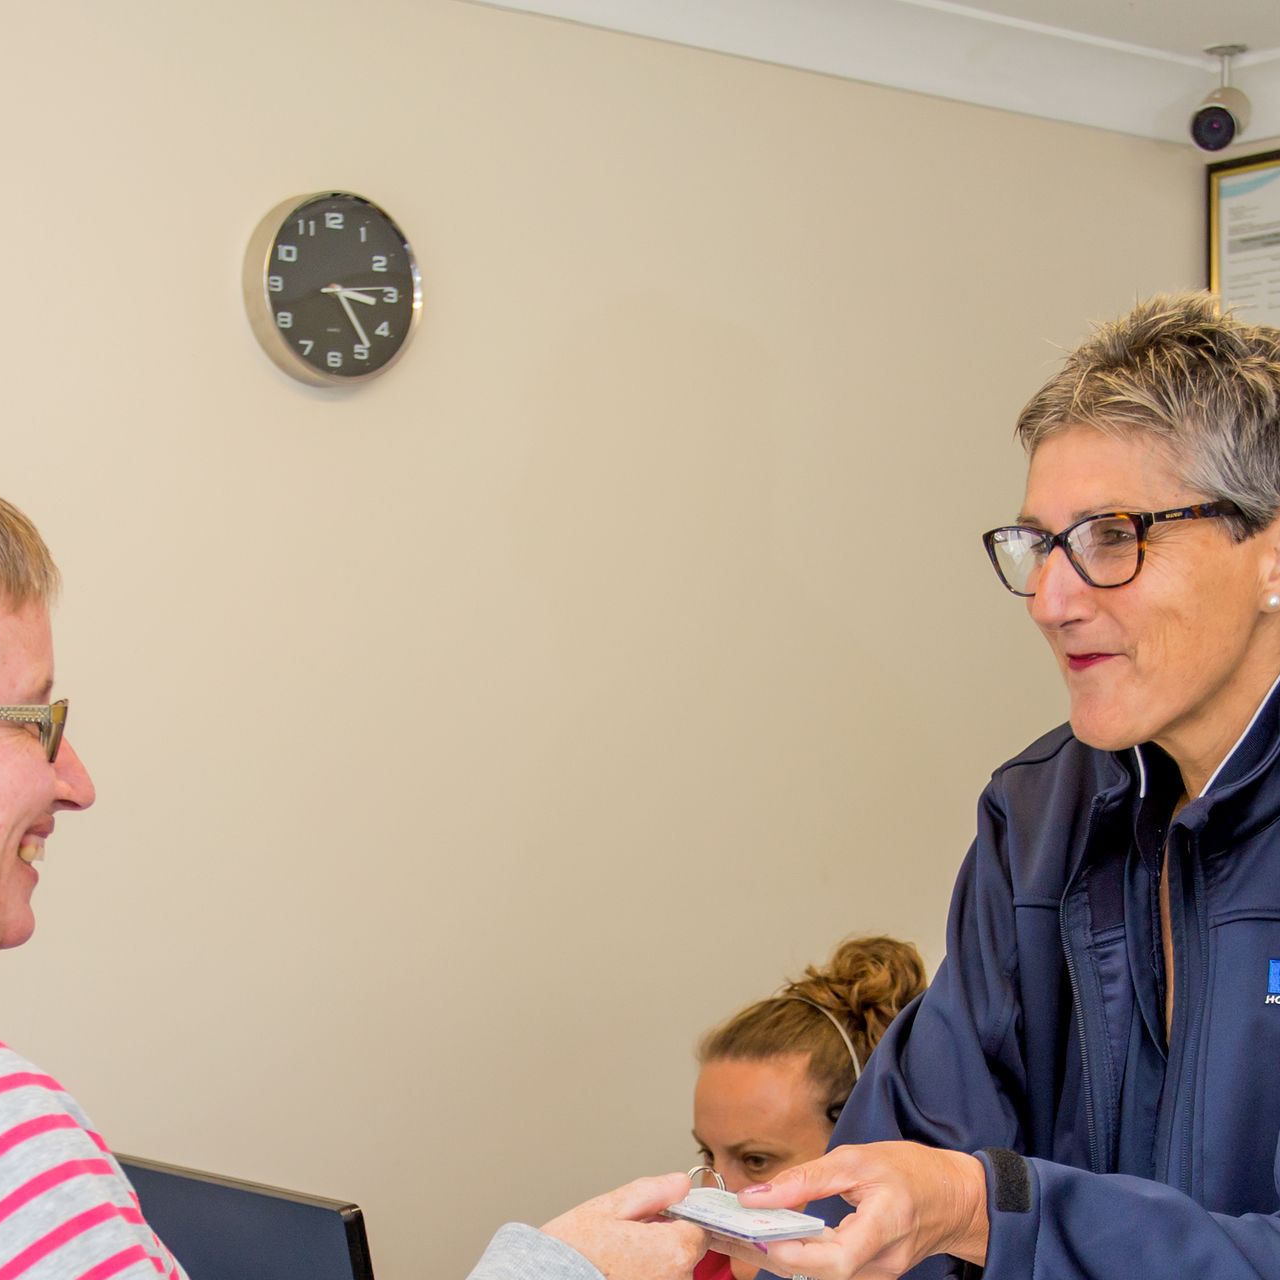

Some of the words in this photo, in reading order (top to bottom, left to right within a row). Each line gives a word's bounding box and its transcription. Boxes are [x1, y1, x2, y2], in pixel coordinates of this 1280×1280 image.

[297, 219, 316, 237] 11
[324, 212, 344, 230] 12
[359, 226, 367, 242] 1
[277, 244, 297, 262] 10
[371, 255, 388, 272] 2
[269, 275, 284, 292] 9
[382, 286, 398, 303] 3
[276, 311, 293, 328] 8
[374, 321, 390, 337] 4
[298, 340, 314, 356] 7
[353, 343, 369, 360] 5
[326, 352, 343, 367] 6
